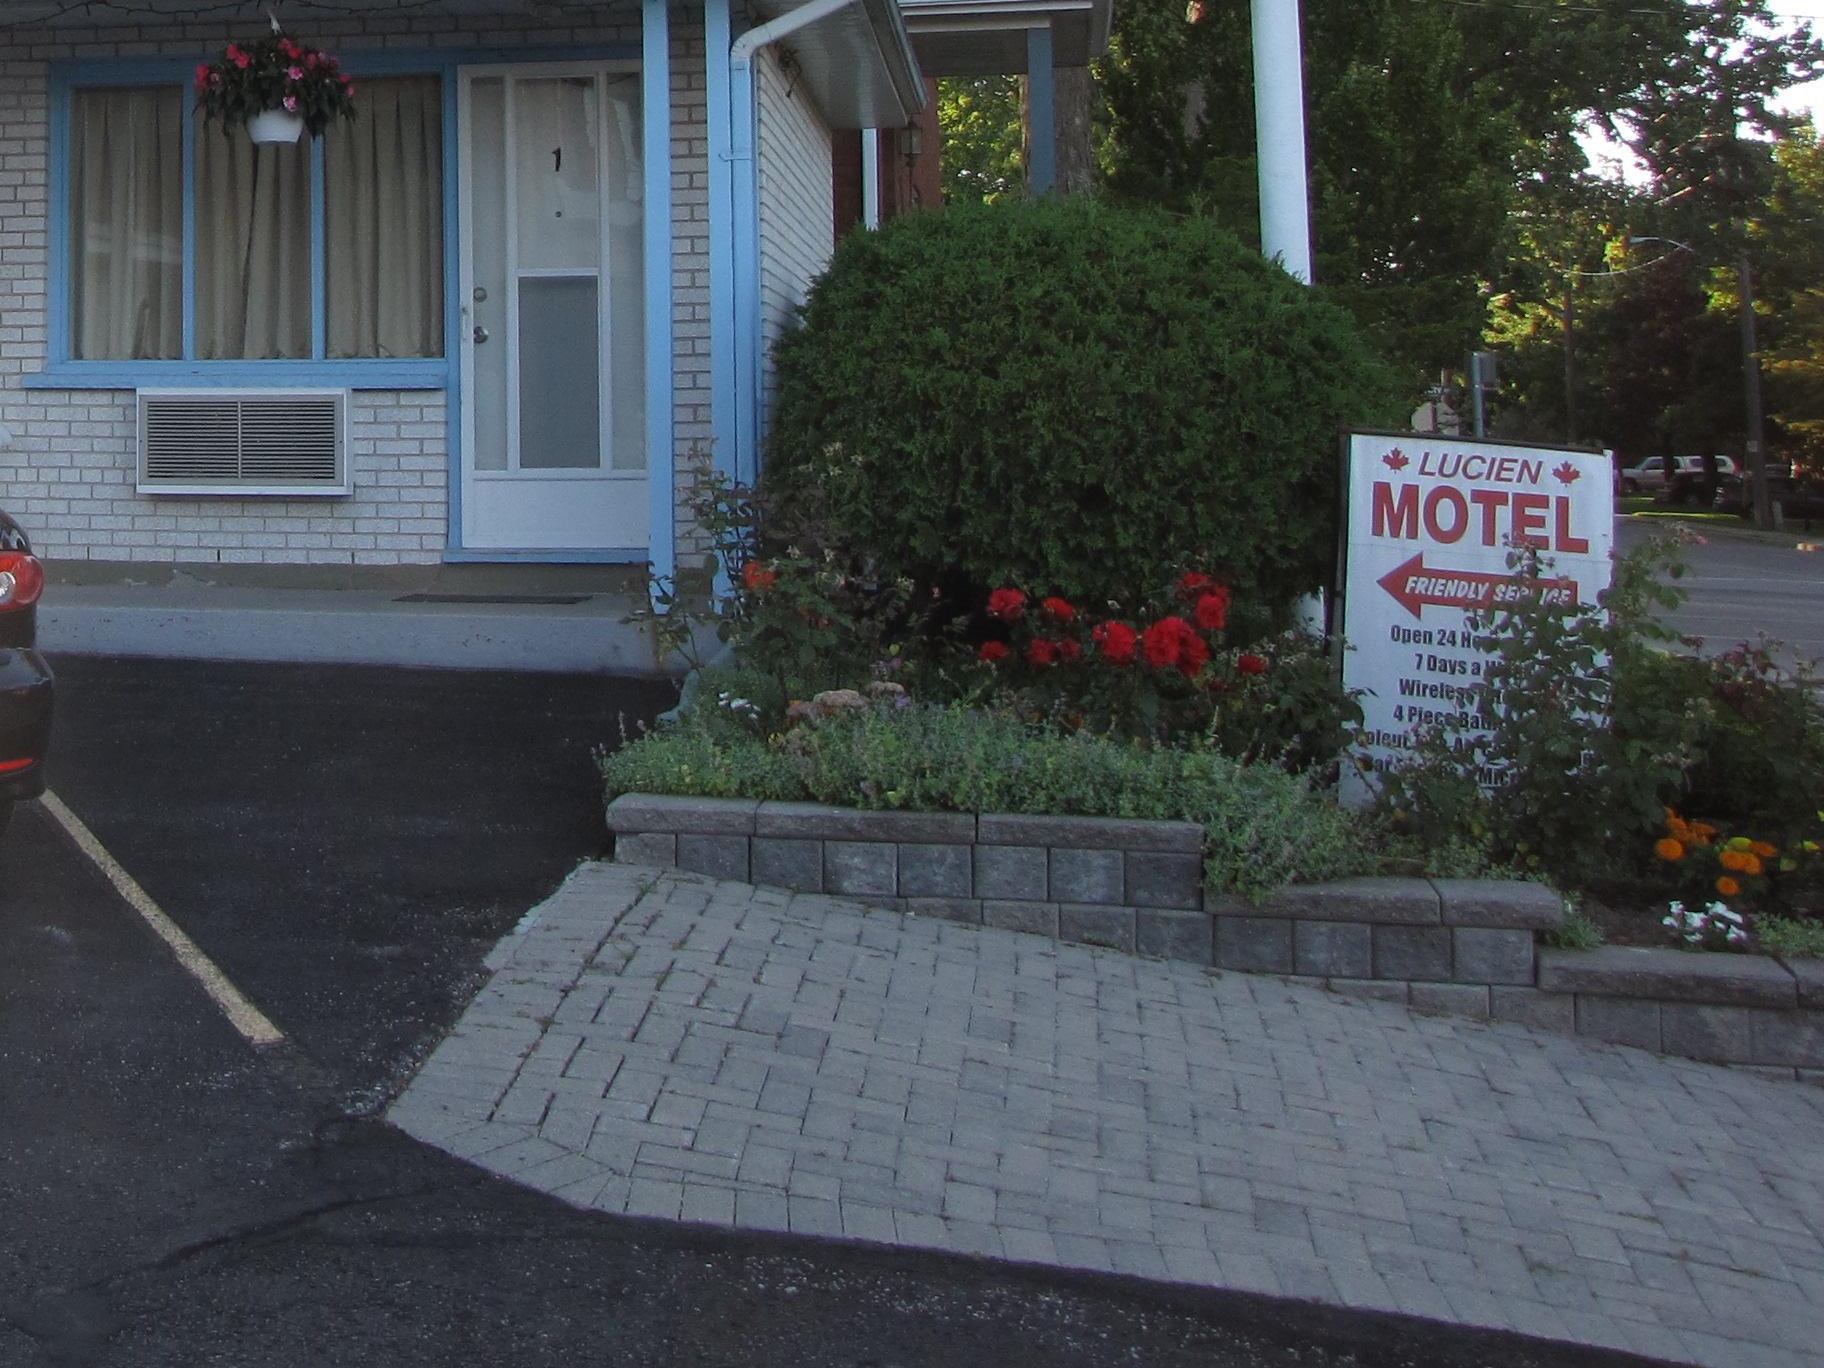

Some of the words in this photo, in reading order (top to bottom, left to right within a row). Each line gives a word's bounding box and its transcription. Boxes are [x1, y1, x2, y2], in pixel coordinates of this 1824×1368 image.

[552, 147, 561, 172] 1
[1418, 451, 1544, 484] LUCIEN
[1371, 481, 1589, 554] MOTEL
[1405, 576, 1490, 601] FRIENDLY
[1493, 584, 1571, 606] SERICE
[1391, 624, 1432, 644] Open
[1437, 629, 1457, 646] 24
[1415, 653, 1424, 670] 7
[1427, 655, 1467, 675] Days
[1471, 662, 1481, 675] a
[1393, 705, 1403, 722] 4
